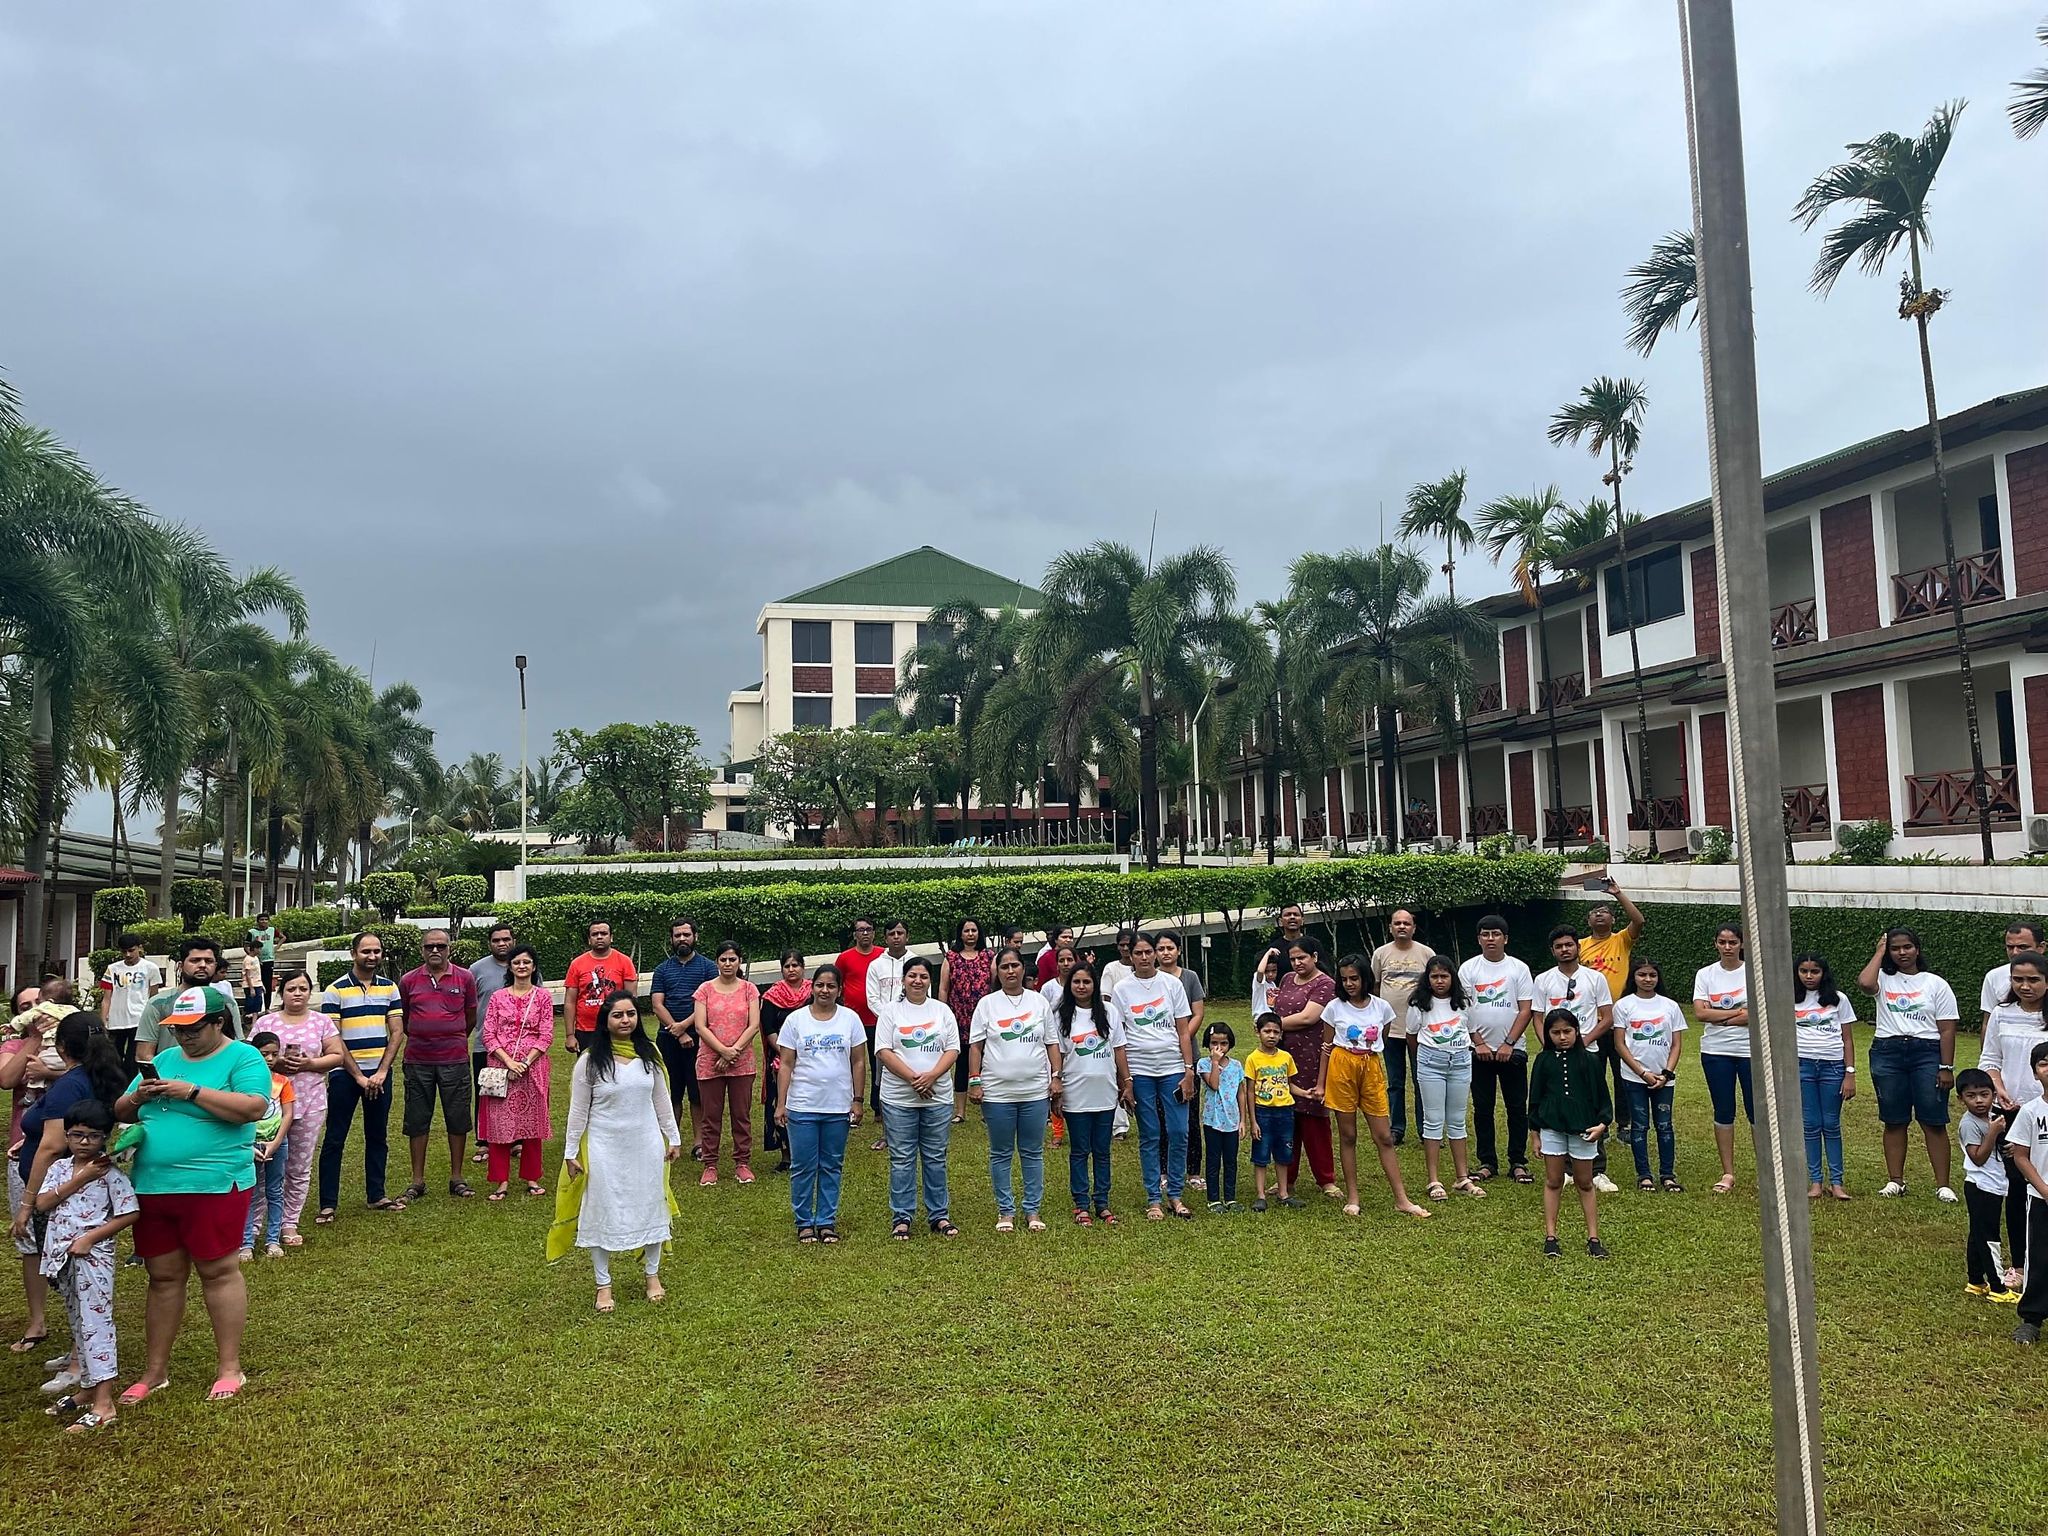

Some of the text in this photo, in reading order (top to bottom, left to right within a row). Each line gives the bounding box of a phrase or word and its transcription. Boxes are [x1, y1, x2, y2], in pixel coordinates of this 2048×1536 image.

[1491, 998, 1511, 1008] India
[1903, 1011, 1927, 1021] India
[1152, 1019, 1171, 1028] India
[920, 1042, 941, 1052] India
[1648, 1037, 1668, 1047] India
